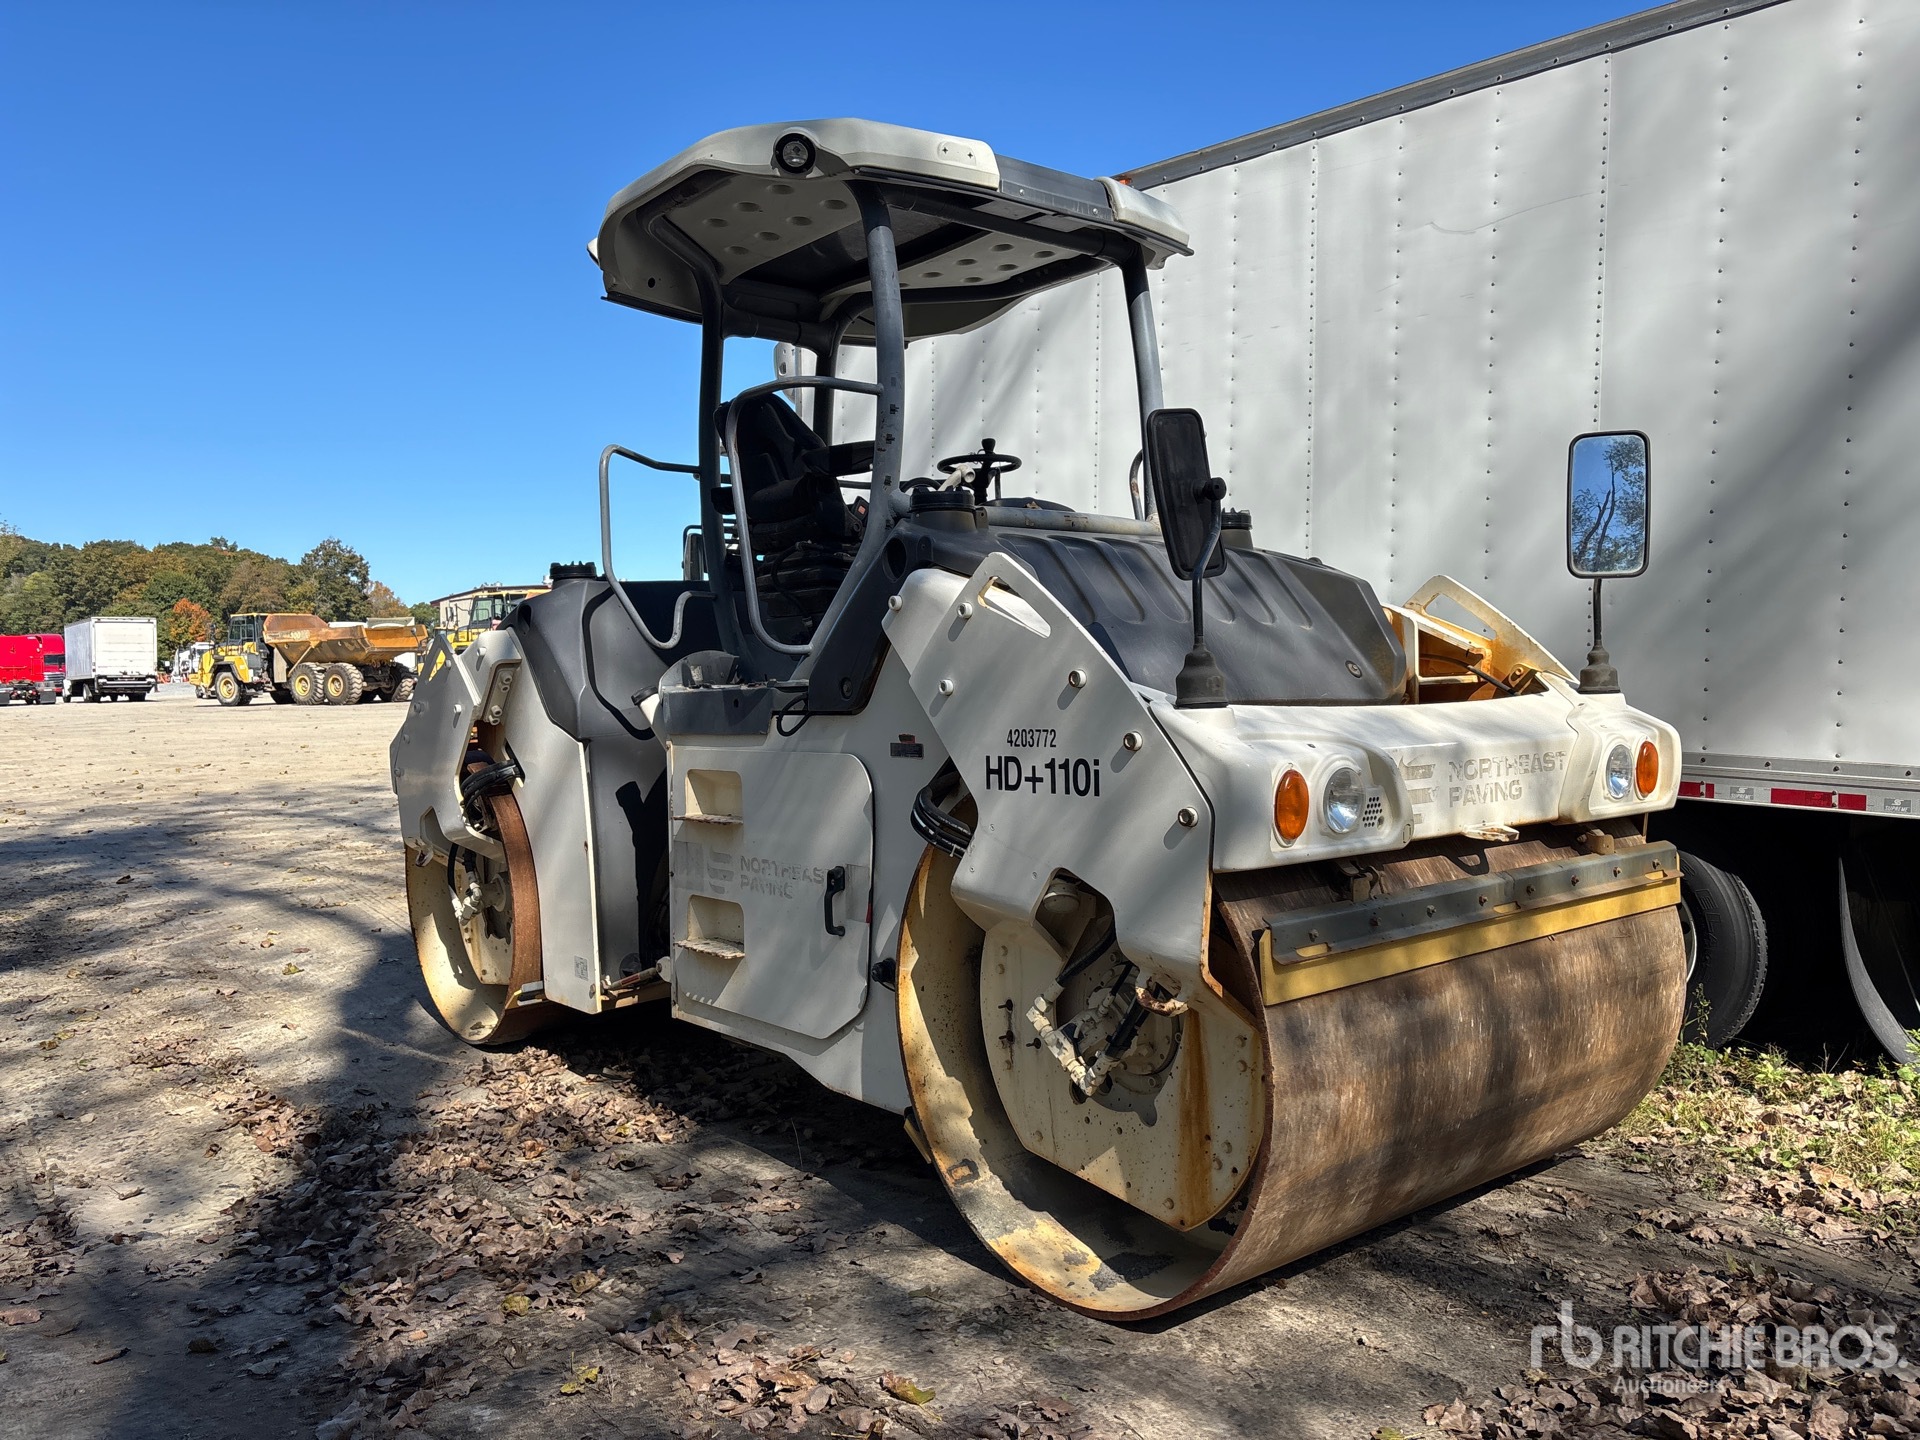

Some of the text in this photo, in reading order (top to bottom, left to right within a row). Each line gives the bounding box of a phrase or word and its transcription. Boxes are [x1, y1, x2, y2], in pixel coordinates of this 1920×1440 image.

[1006, 728, 1057, 748] 4203772
[985, 755, 1100, 797] HD+110i
[1448, 750, 1567, 782] NORTHEAST
[1448, 779, 1523, 807] PAVING
